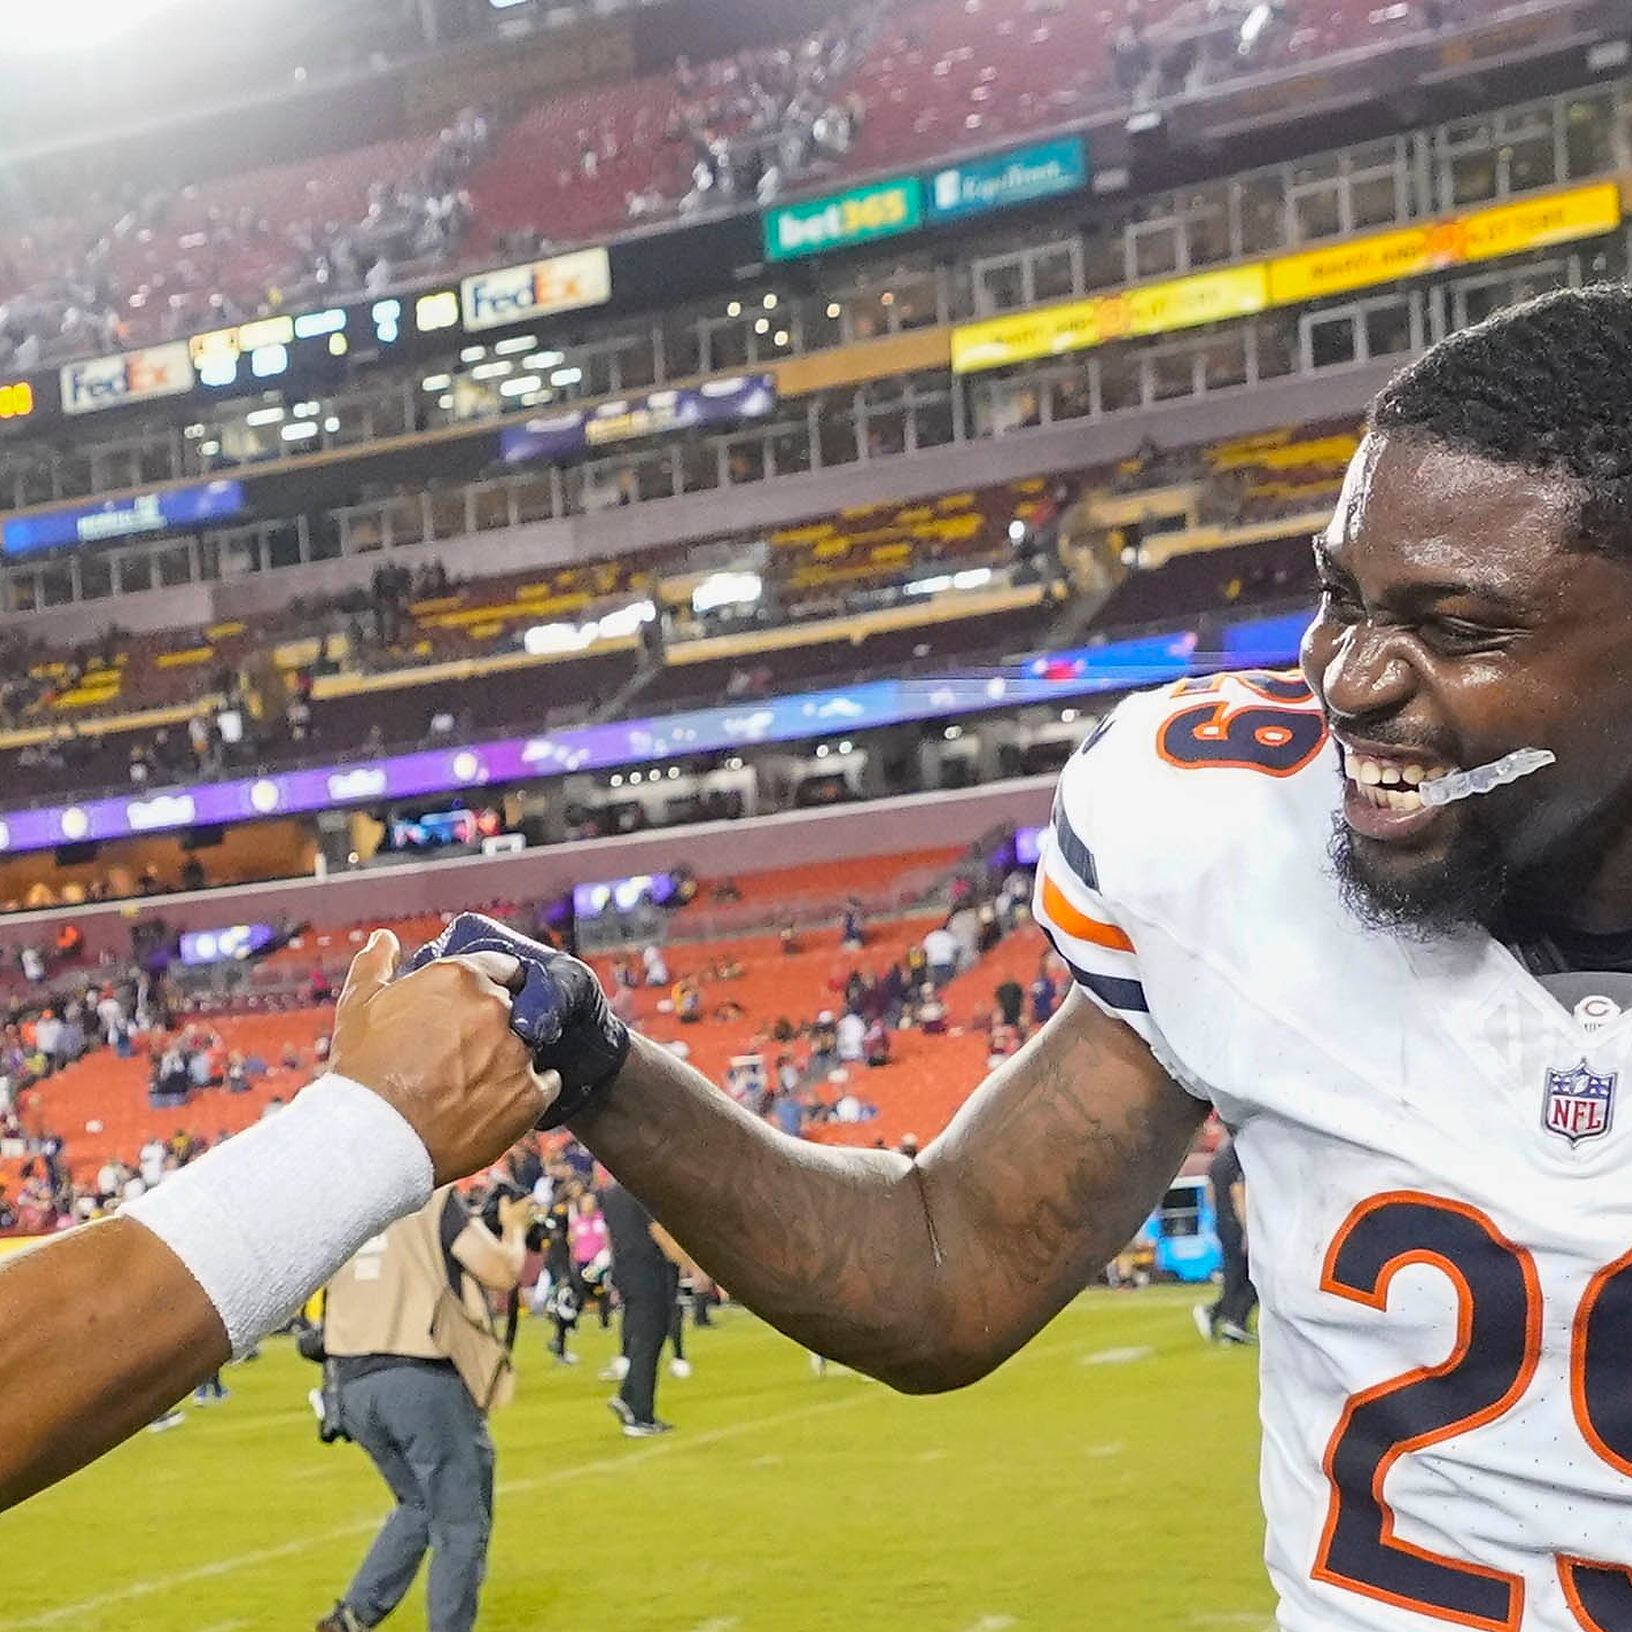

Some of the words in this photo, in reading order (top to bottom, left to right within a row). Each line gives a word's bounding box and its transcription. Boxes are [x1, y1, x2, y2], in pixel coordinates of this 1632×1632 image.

[778, 188, 906, 248] bet365
[472, 265, 582, 320] FedEx
[70, 354, 167, 404] FedEx
[1552, 1098, 1601, 1133] NFL
